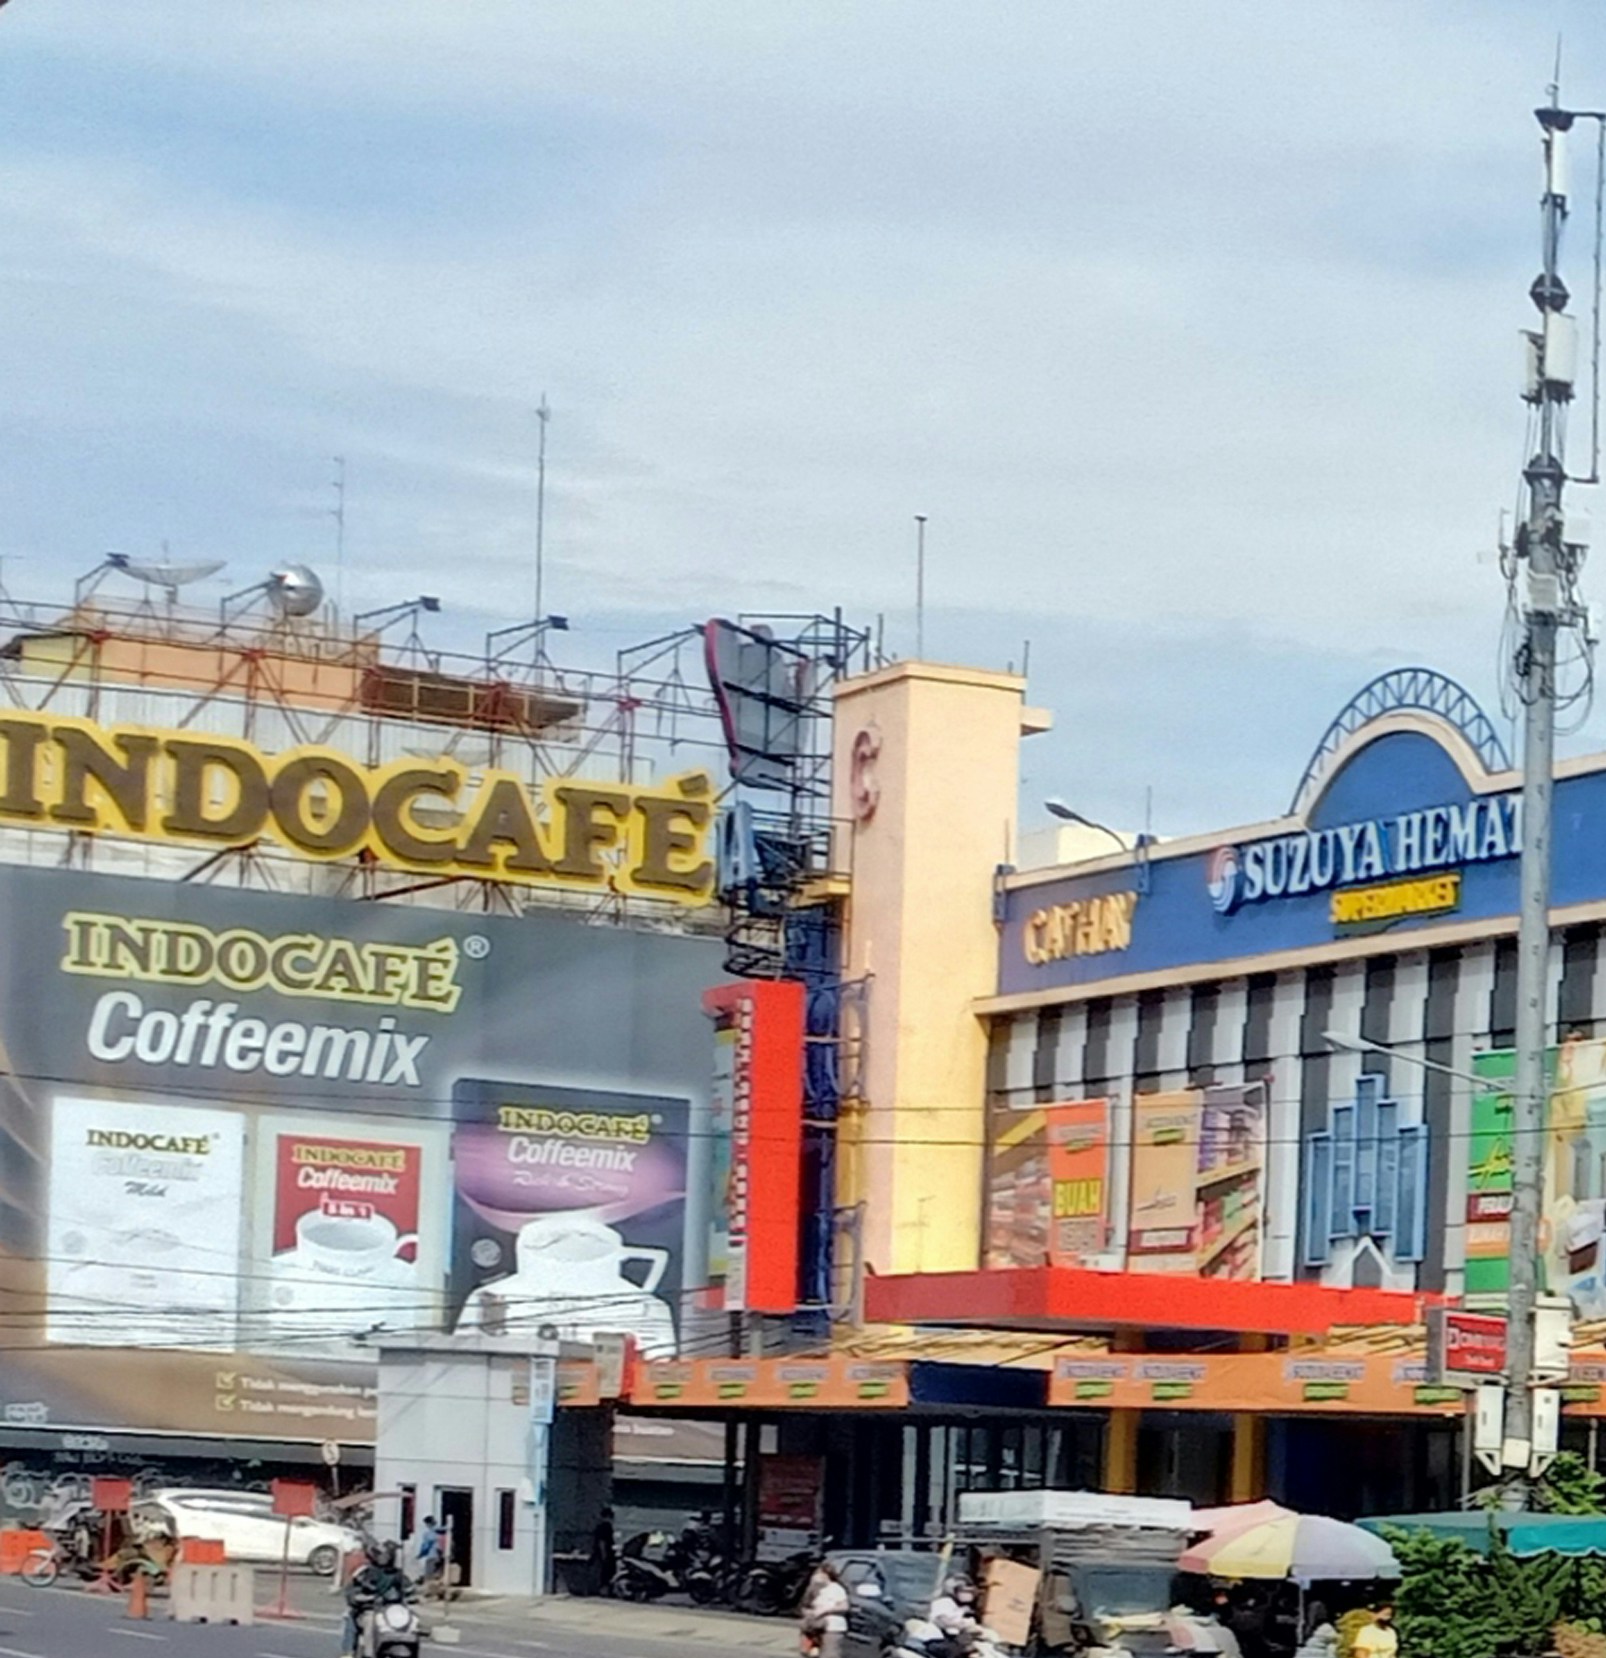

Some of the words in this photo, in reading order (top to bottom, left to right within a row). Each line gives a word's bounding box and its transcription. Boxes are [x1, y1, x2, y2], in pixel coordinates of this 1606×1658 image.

[0, 720, 713, 893] INDOCAFÉ
[1243, 820, 1387, 901] SUZUYA
[1394, 794, 1524, 872] HEMAT
[1023, 891, 1138, 966] CATHAY
[67, 919, 459, 1005] INDOCAFÉ
[87, 990, 429, 1087] Coffeemix
[86, 1129, 210, 1155] INDOCAFÉ
[500, 1107, 650, 1144] INDOCAFÉ
[292, 1144, 405, 1171] INDOCAFÉ
[507, 1135, 638, 1173] Coffeemix
[297, 1166, 399, 1196] Coffeemix
[1053, 1179, 1102, 1218] BUAH
